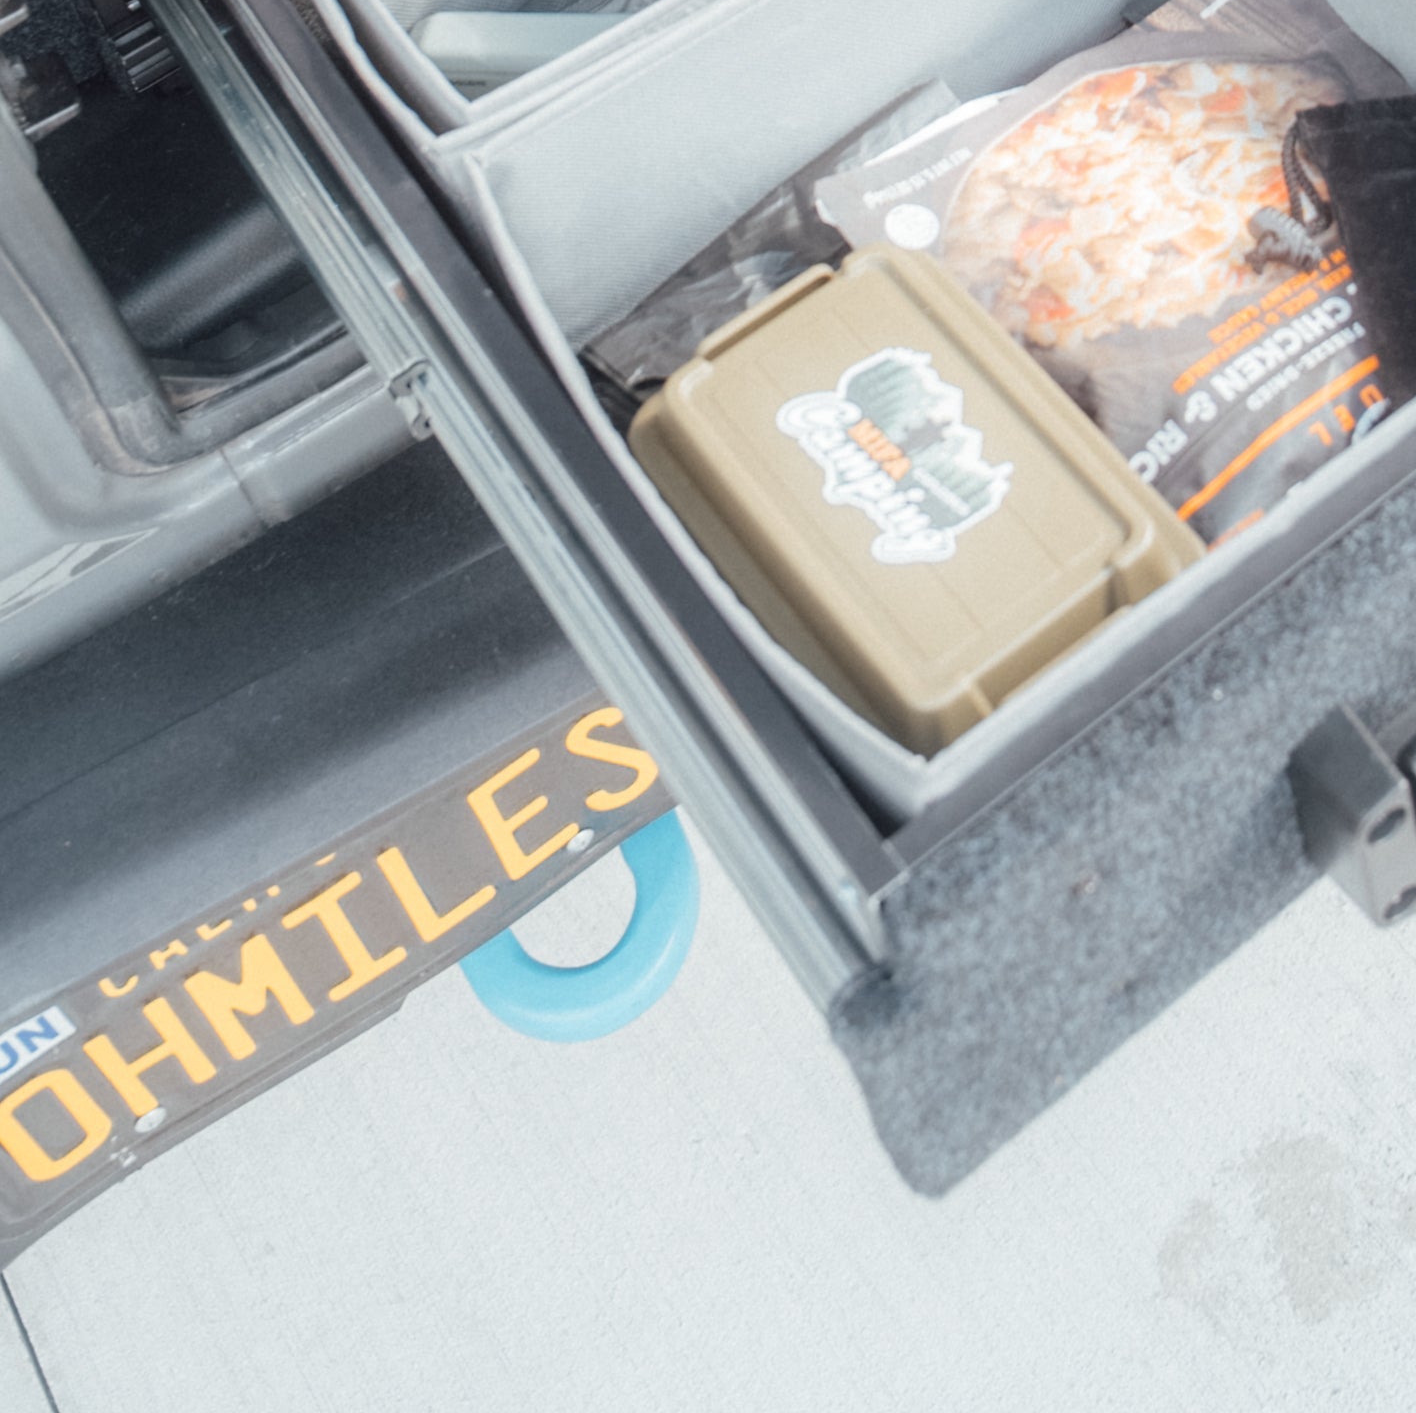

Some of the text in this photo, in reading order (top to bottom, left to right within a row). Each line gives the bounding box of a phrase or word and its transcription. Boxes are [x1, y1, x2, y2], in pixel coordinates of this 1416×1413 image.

[1128, 296, 1352, 484] CHICKEN & RIC
[1308, 383, 1385, 446] UEL
